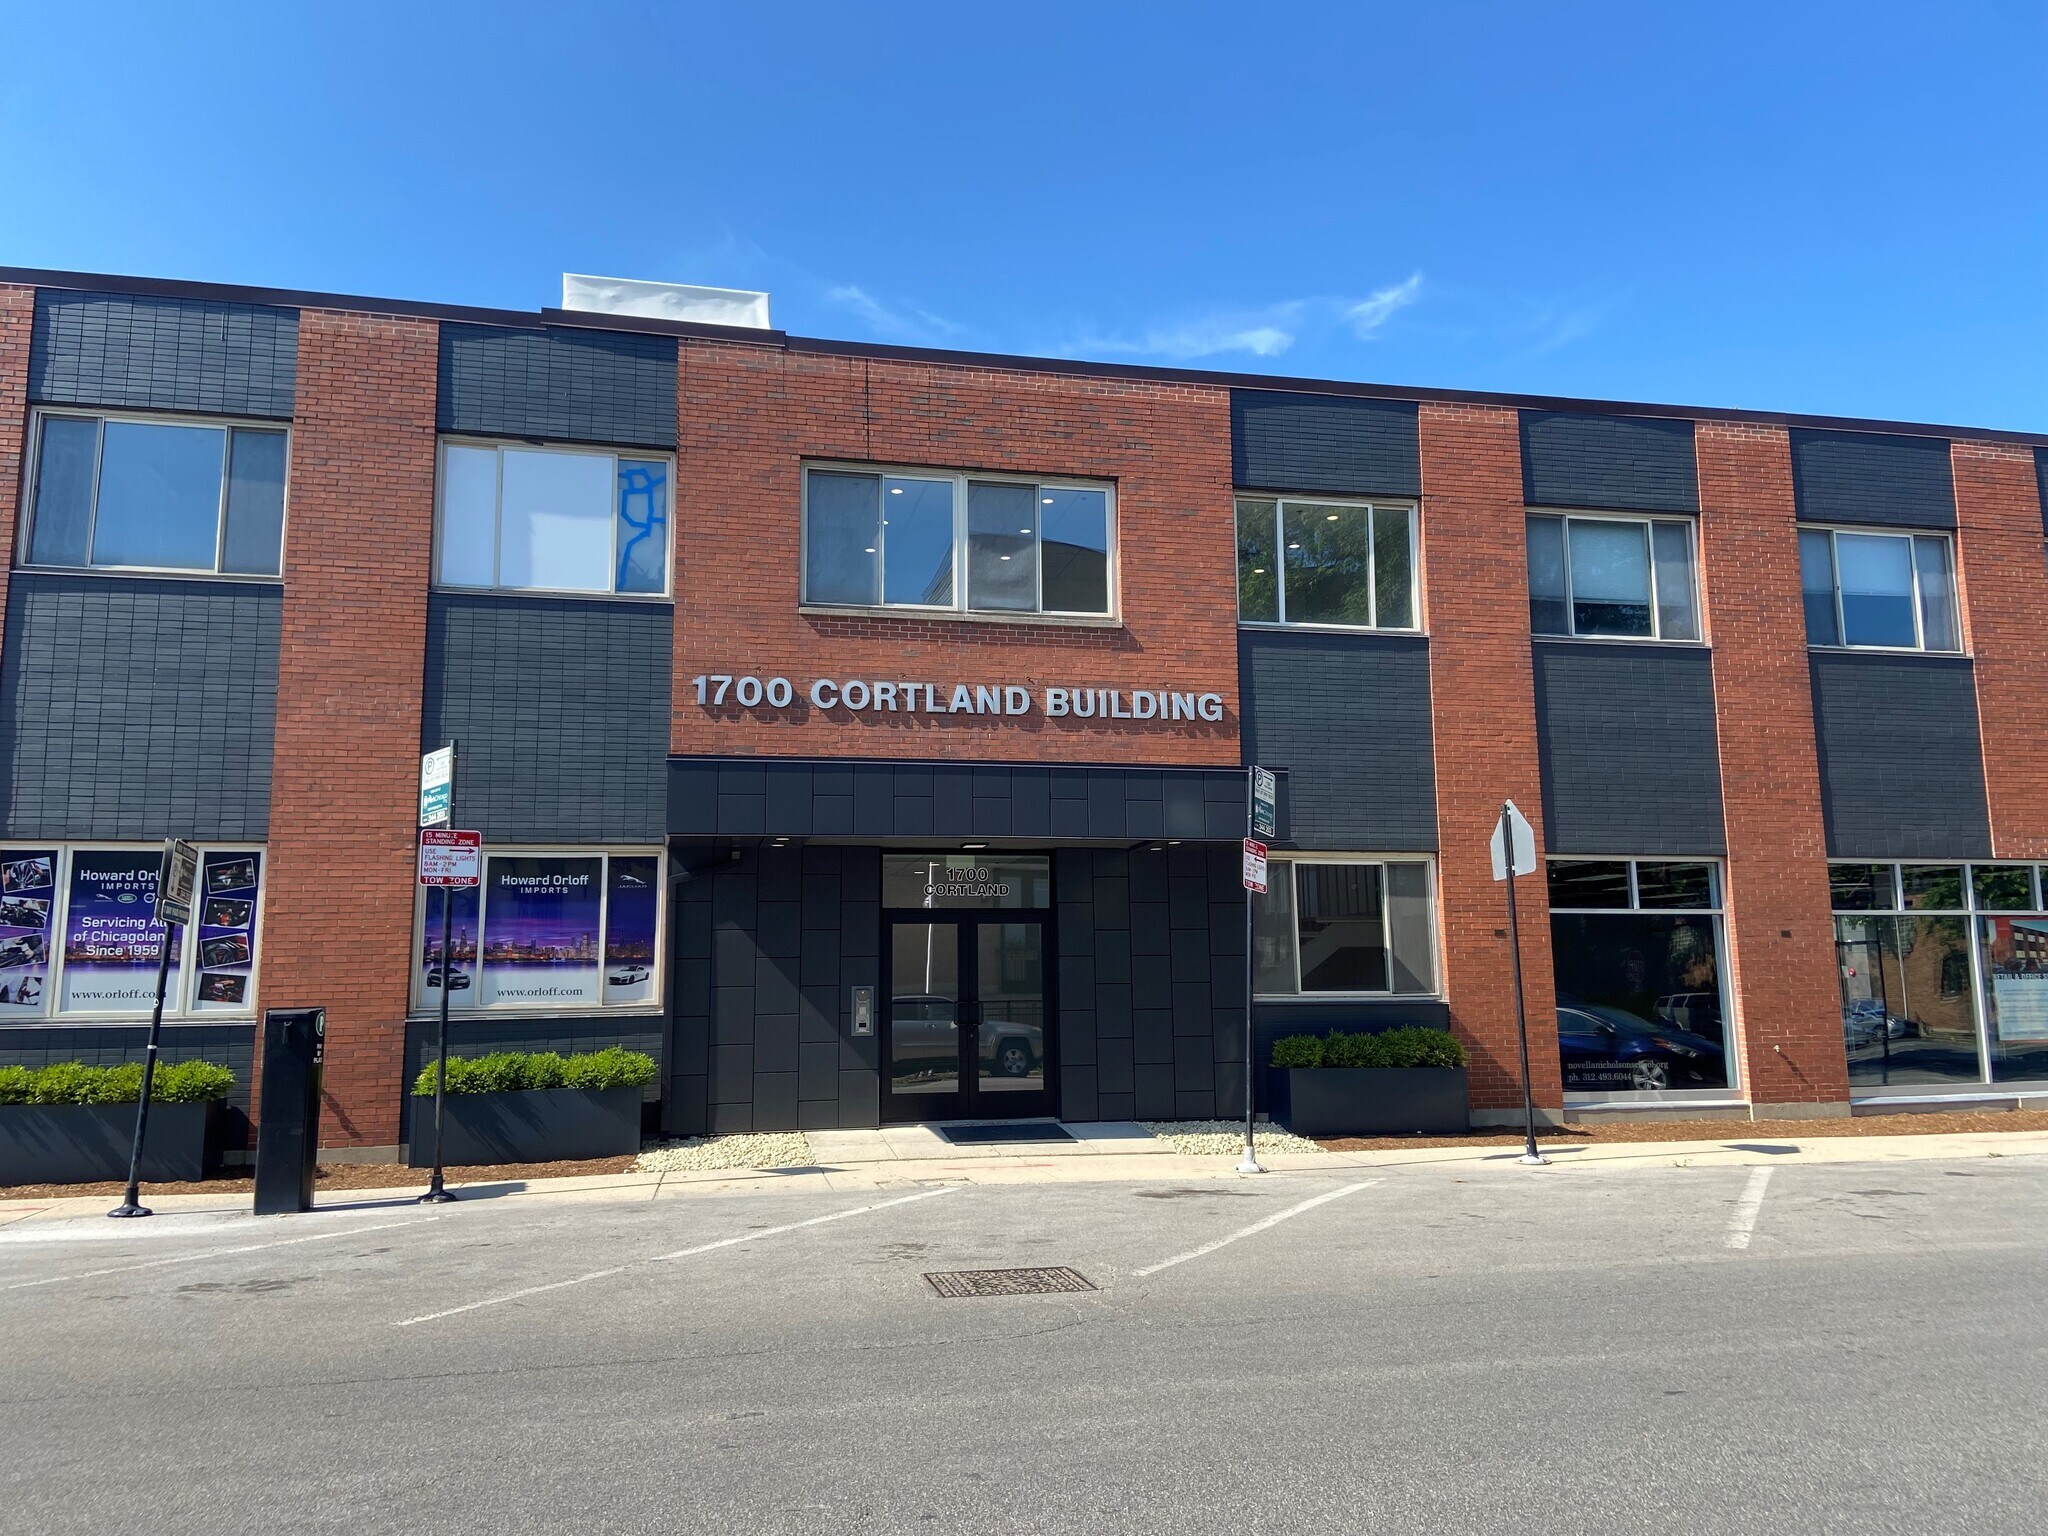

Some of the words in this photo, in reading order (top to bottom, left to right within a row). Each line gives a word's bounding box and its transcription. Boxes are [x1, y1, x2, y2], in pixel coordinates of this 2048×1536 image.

[692, 674, 793, 708] 1700
[810, 678, 1031, 716] CORTLAND
[1046, 687, 1224, 722] BUILDING
[80, 869, 135, 881] Howard
[138, 869, 160, 881] Orl
[501, 874, 550, 885] Howard
[553, 874, 589, 885] Orloff
[946, 867, 989, 882] 1700
[101, 882, 155, 890] IMPORTS
[423, 876, 444, 884] TOW
[448, 877, 474, 885] ZONE
[923, 883, 1010, 897] CORTLAND
[82, 916, 146, 930] Servicing
[73, 930, 88, 942] of
[91, 930, 166, 944] Chicagolan
[86, 944, 123, 956] Since
[127, 944, 159, 956] 1959
[71, 989, 166, 999] www.orloff.co
[497, 987, 583, 997] www.orloff.com
[1567, 1059, 1669, 1070] novellanicholsonscol.org
[1568, 1072, 1581, 1083] ph.
[1582, 1072, 1632, 1082] 312.493.6044
